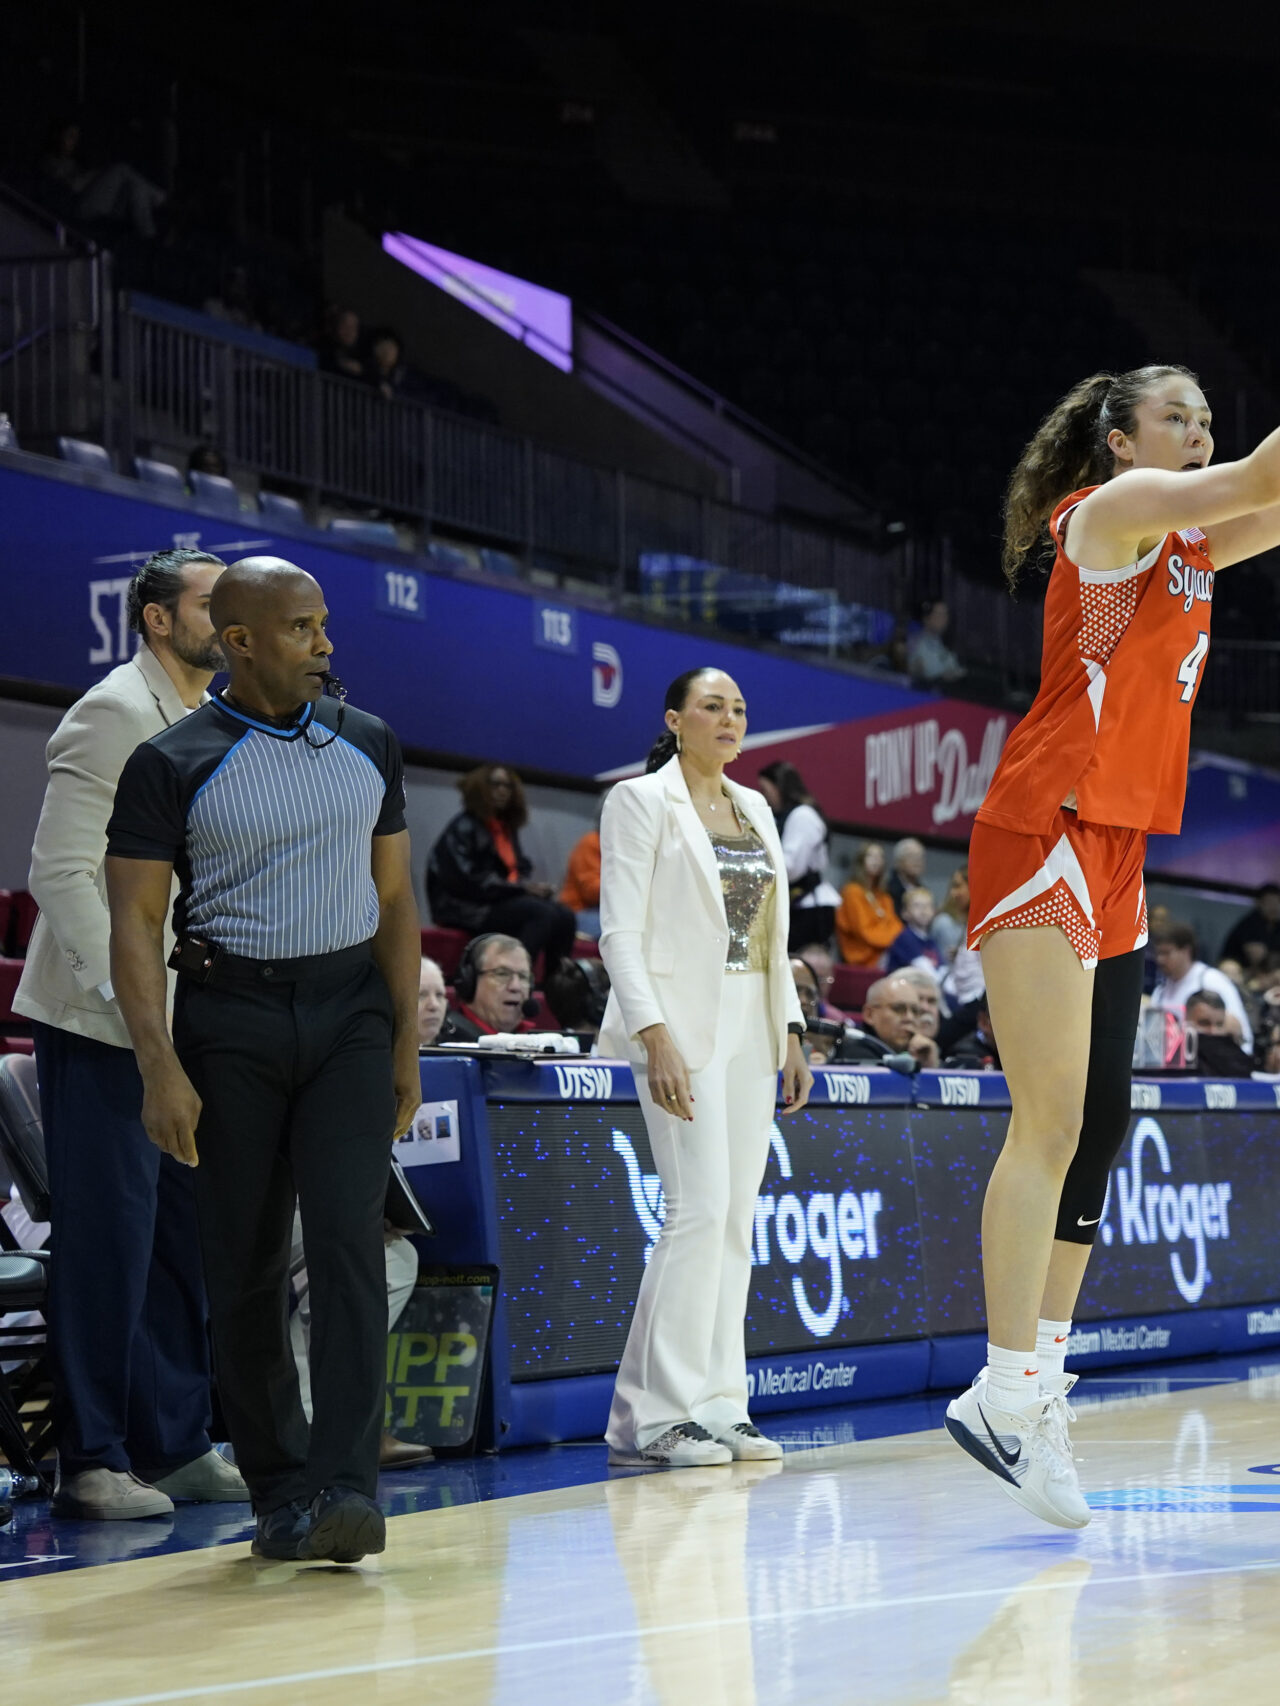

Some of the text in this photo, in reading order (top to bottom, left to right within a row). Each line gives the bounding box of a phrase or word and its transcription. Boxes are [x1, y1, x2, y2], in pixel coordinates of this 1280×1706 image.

[386, 571, 419, 612] 112
[1167, 554, 1214, 614] Syrac
[541, 608, 571, 646] 113
[1176, 631, 1209, 703] 4
[914, 719, 939, 794] UP
[932, 716, 1007, 825] Dall
[555, 1066, 612, 1099] UTSW
[824, 1073, 870, 1104] UTSW
[938, 1076, 981, 1105] UTSW
[1116, 1117, 1232, 1303] Kroger
[418, 1274, 491, 1287] lipp-nott.com
[1101, 1327, 1138, 1352] Medical
[1138, 1325, 1171, 1350] Center
[385, 1333, 478, 1384] IPP
[758, 1364, 812, 1396] Medical
[813, 1362, 858, 1390] Center
